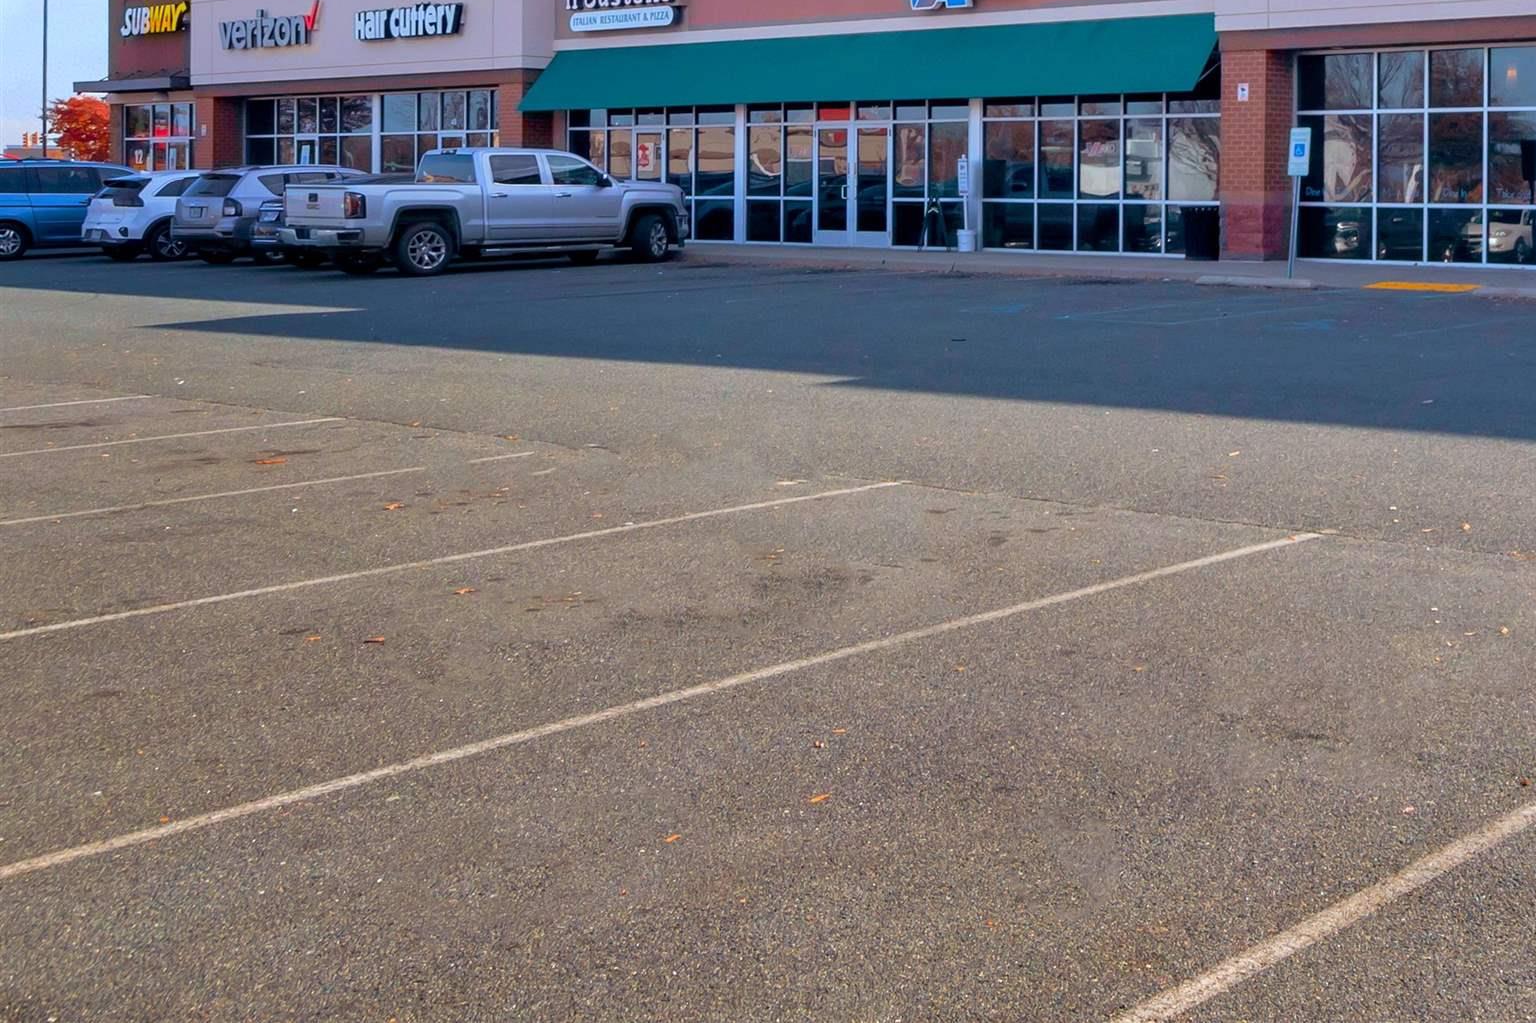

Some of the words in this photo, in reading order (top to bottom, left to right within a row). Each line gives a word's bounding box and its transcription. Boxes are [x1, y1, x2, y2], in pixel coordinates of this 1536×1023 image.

[120, 1, 187, 37] SUBWAY
[219, 8, 310, 50] verizon
[355, 10, 387, 40] Hair
[573, 17, 597, 27] ITALIAN
[600, 13, 641, 25] RESTAURANT
[650, 10, 670, 20] PIZZA
